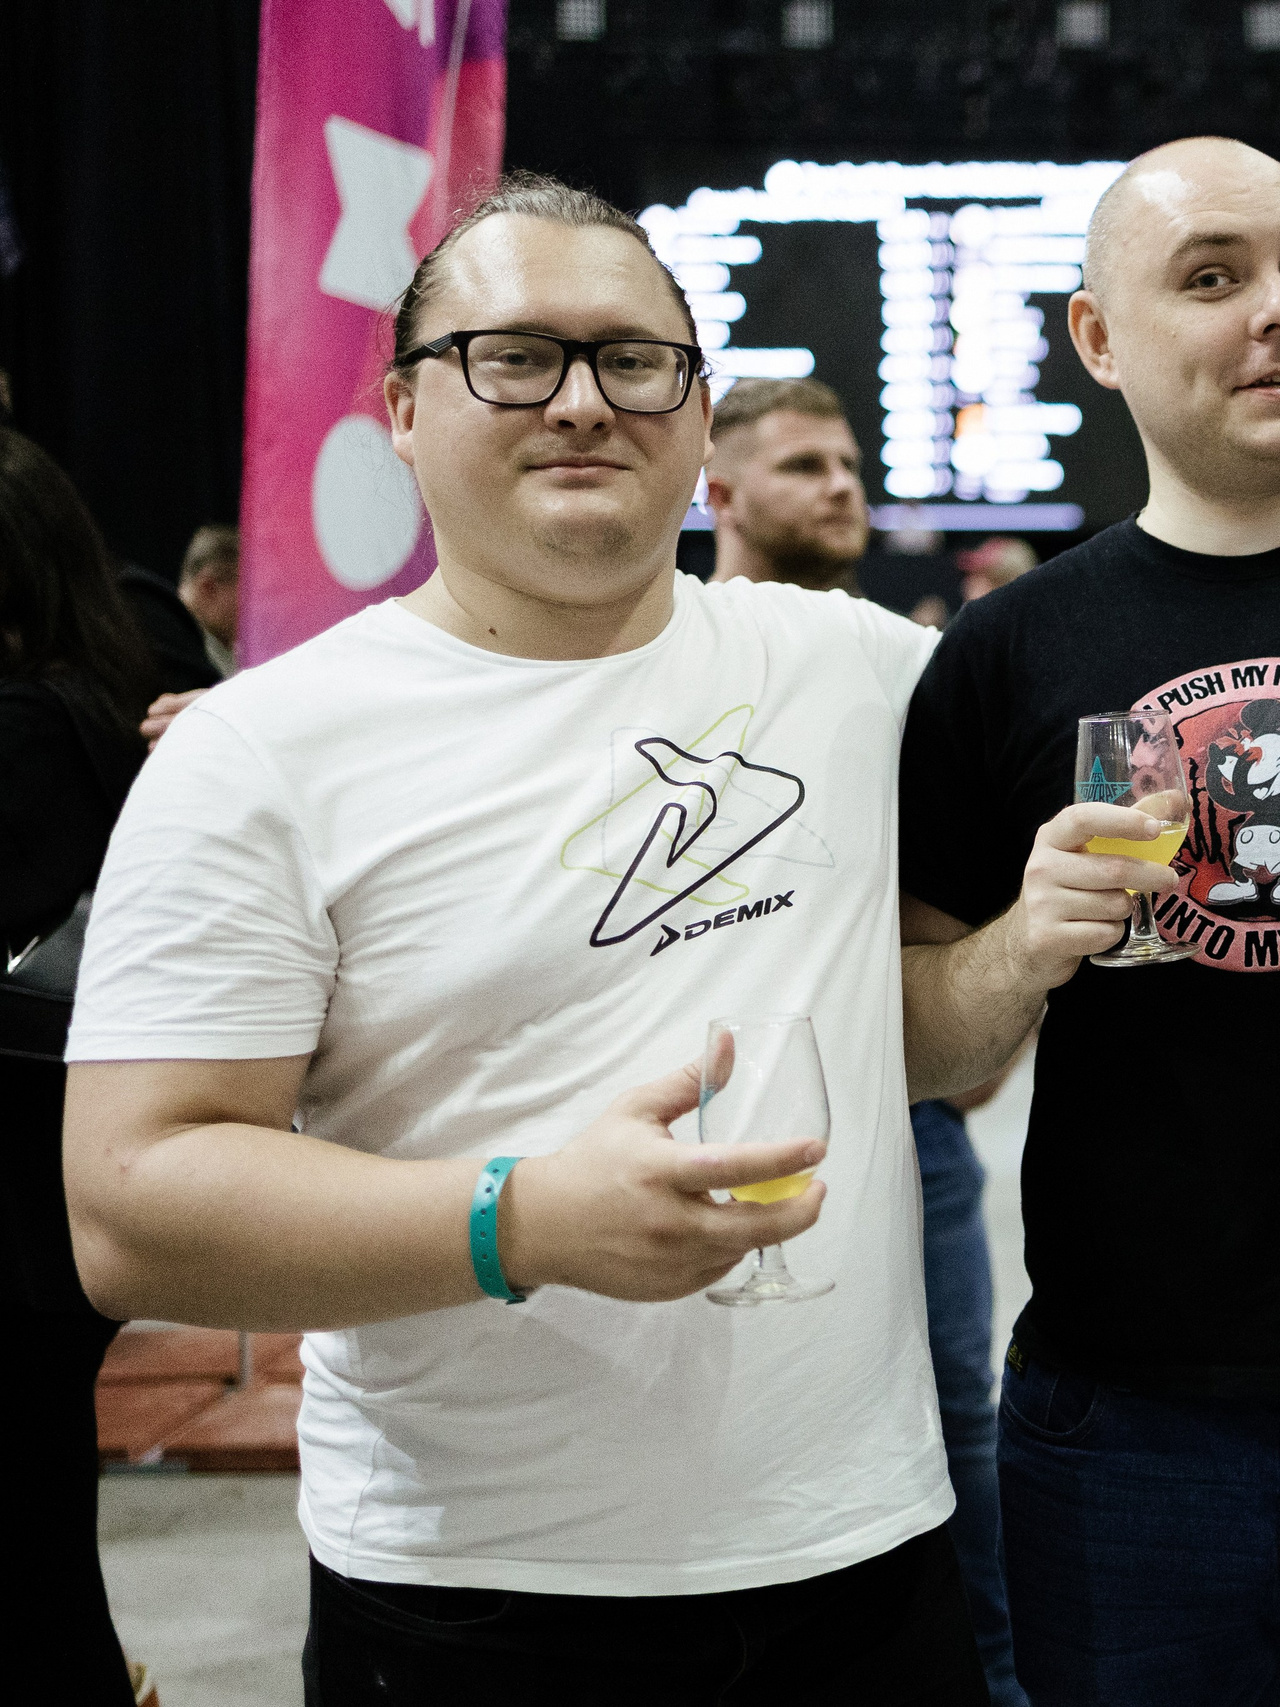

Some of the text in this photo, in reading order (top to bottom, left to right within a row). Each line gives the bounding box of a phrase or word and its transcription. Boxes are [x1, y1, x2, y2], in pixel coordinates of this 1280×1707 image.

[1156, 671, 1226, 714] PUSH
[1231, 664, 1270, 690] MY
[683, 889, 796, 942] DEMIX
[1153, 893, 1236, 961] INTO
